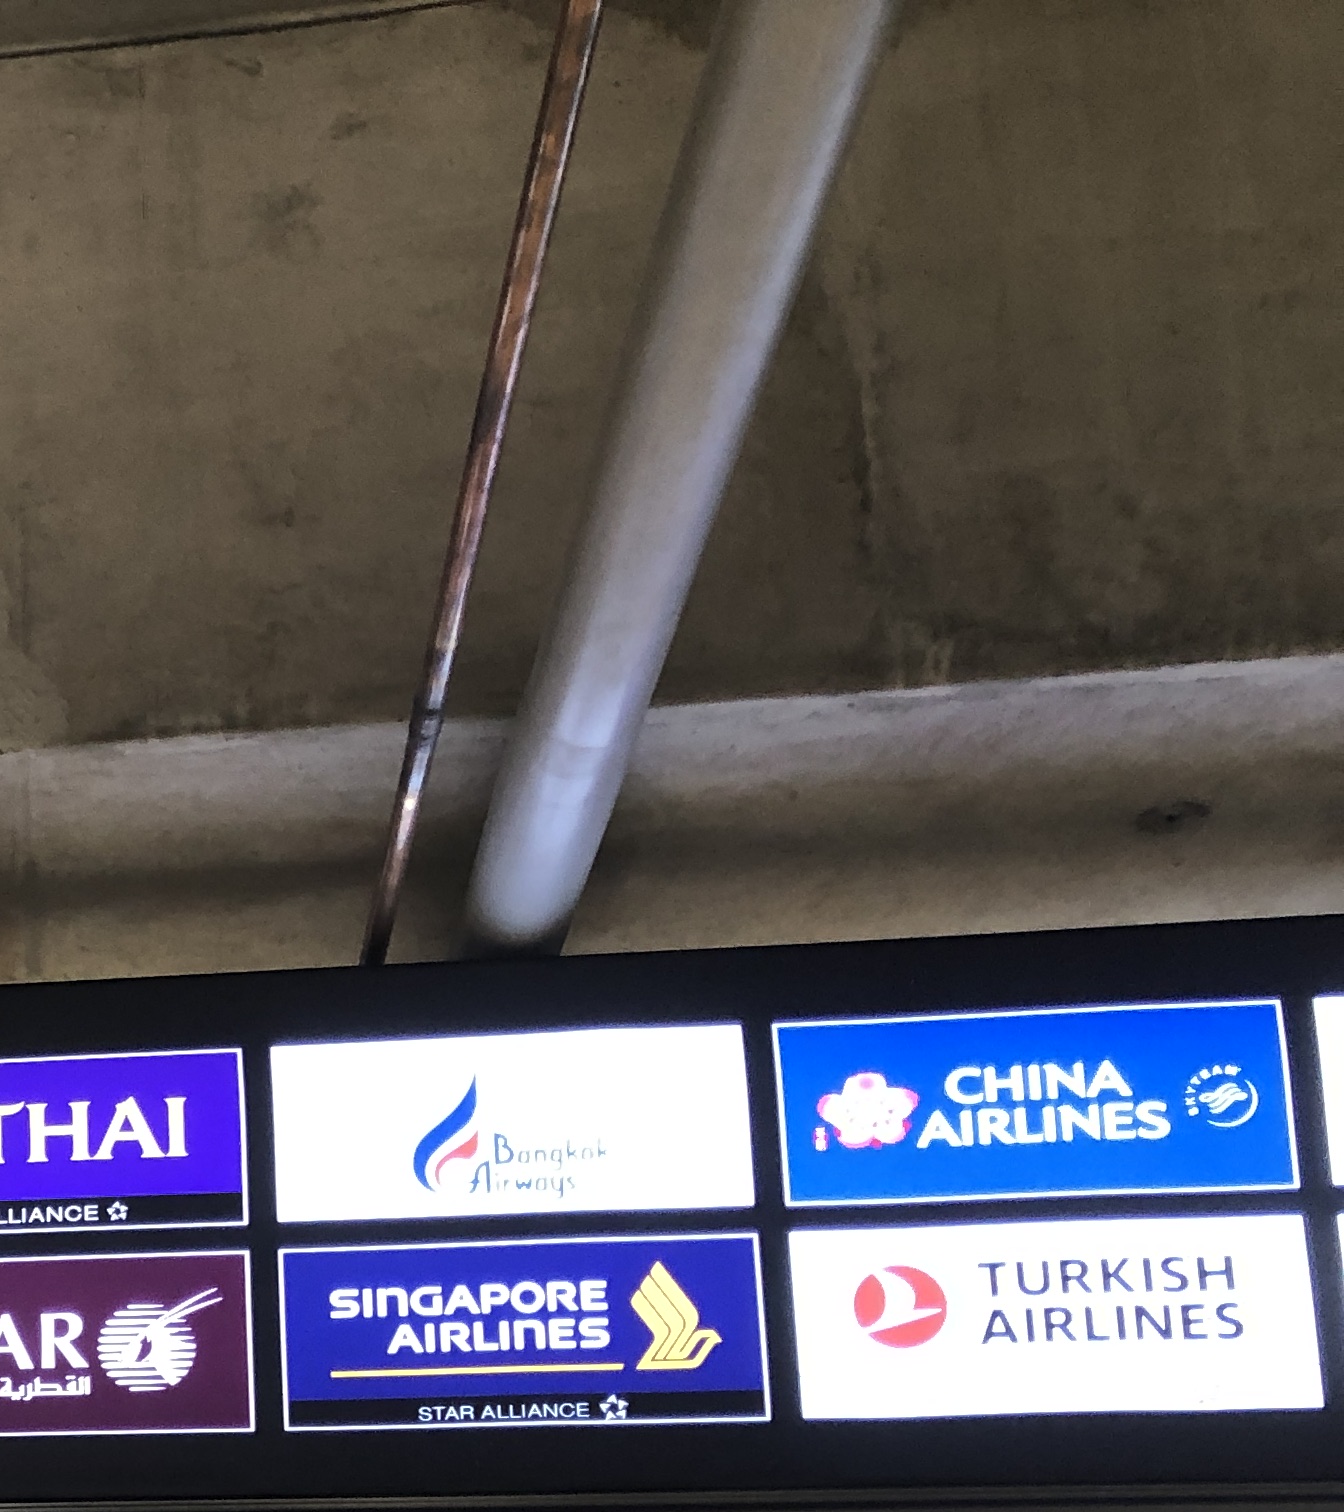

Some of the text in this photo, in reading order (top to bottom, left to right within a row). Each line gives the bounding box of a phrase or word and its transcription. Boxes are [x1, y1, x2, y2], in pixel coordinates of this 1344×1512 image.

[943, 1059, 1135, 1107] CHINA
[915, 1100, 1171, 1150] AIRLINES
[494, 1133, 607, 1170] Bangkok
[469, 1160, 577, 1198] Airways
[978, 1255, 1235, 1297] TURKISH
[328, 1279, 609, 1320] SINGAPORE
[386, 1317, 611, 1355] AIRLINES
[981, 1302, 1244, 1345] AIRLINES
[418, 1402, 590, 1421] STAR ALLIANCE
